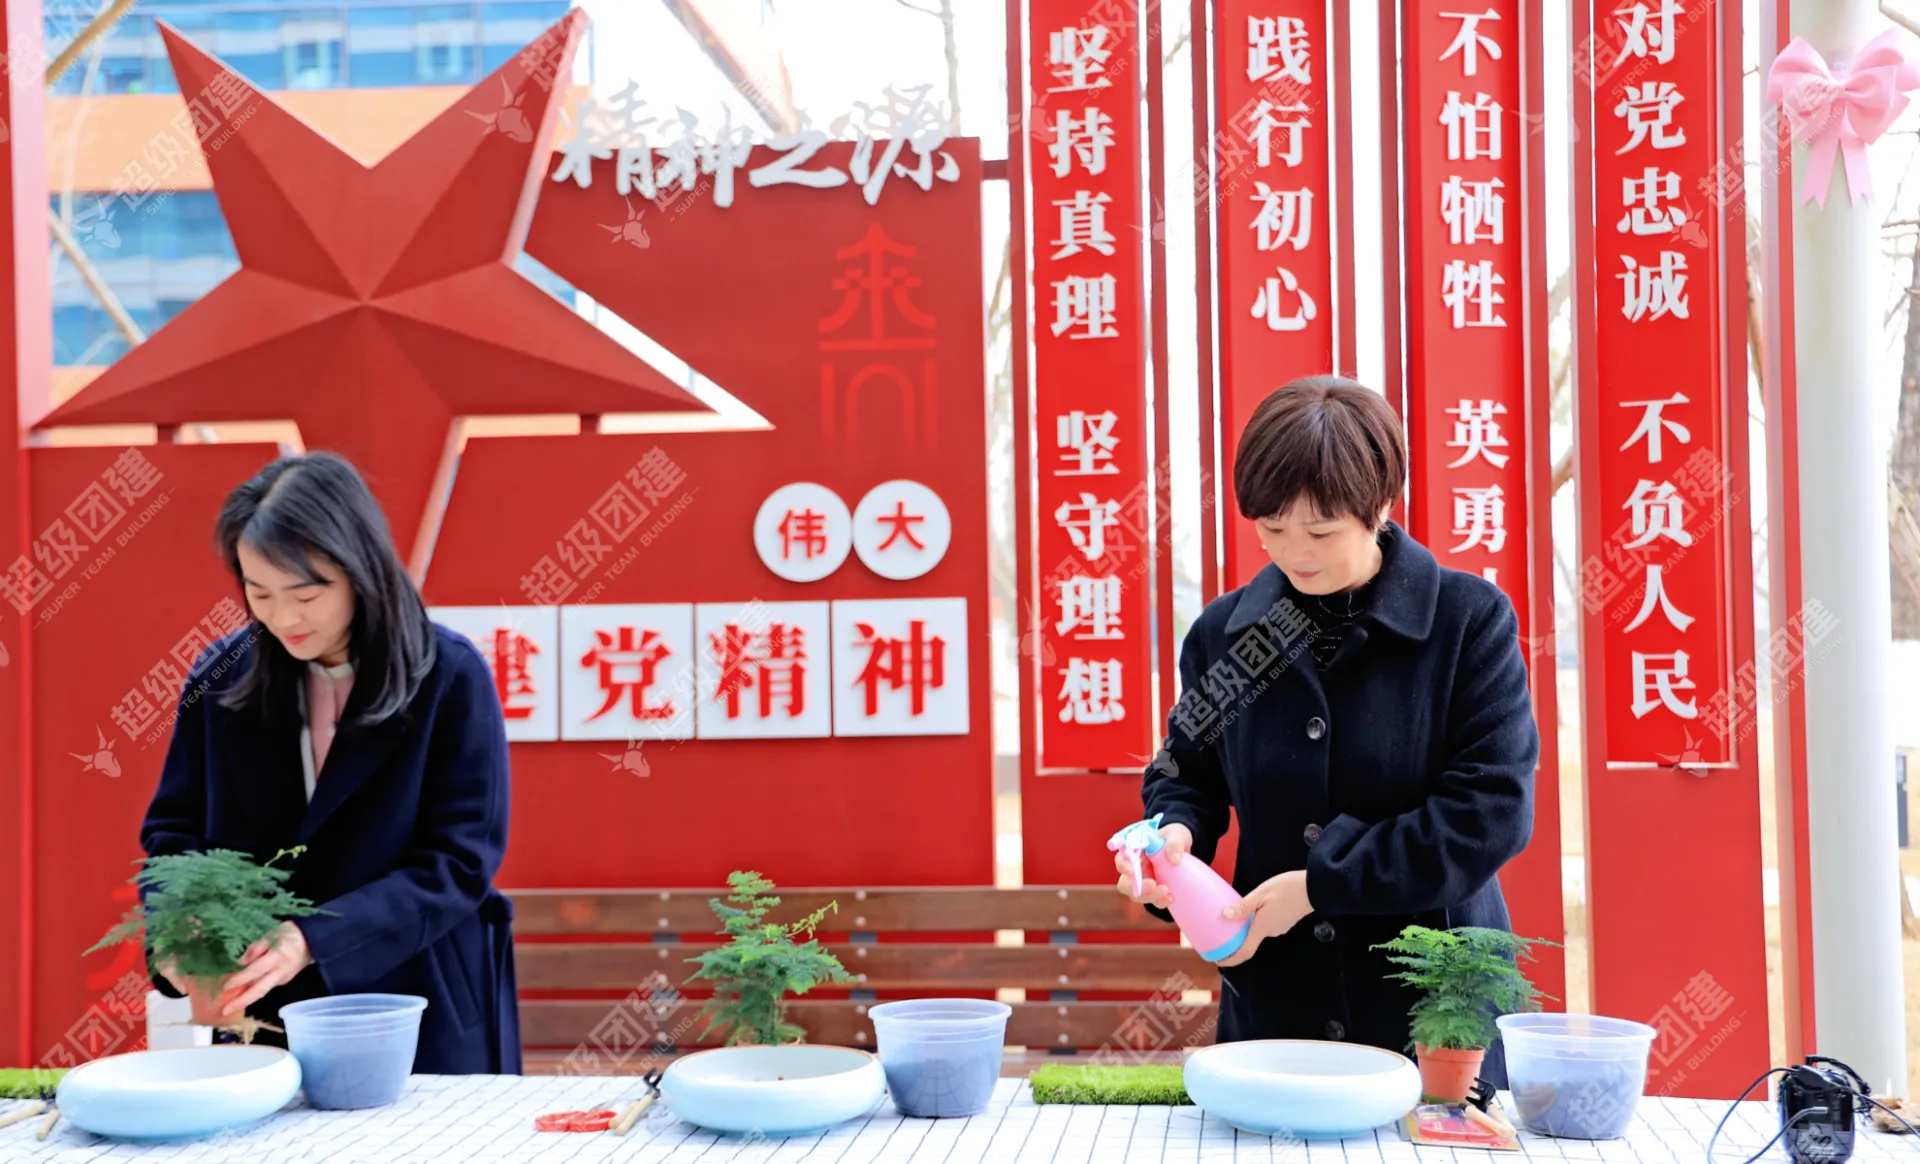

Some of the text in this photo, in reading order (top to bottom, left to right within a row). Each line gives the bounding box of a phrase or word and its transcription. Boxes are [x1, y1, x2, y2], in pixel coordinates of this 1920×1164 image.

[552, 78, 961, 208] 精神之源
[1047, 24, 1119, 339] 坚持真理
[1246, 15, 1317, 331] 践行初心
[1439, 8, 1509, 585] 不怕牺牲 英勇
[1613, 0, 1689, 323] 对党忠诚
[777, 502, 925, 560] 伟大
[1053, 410, 1125, 724] 坚守理想
[1619, 392, 1699, 720] 不负人民
